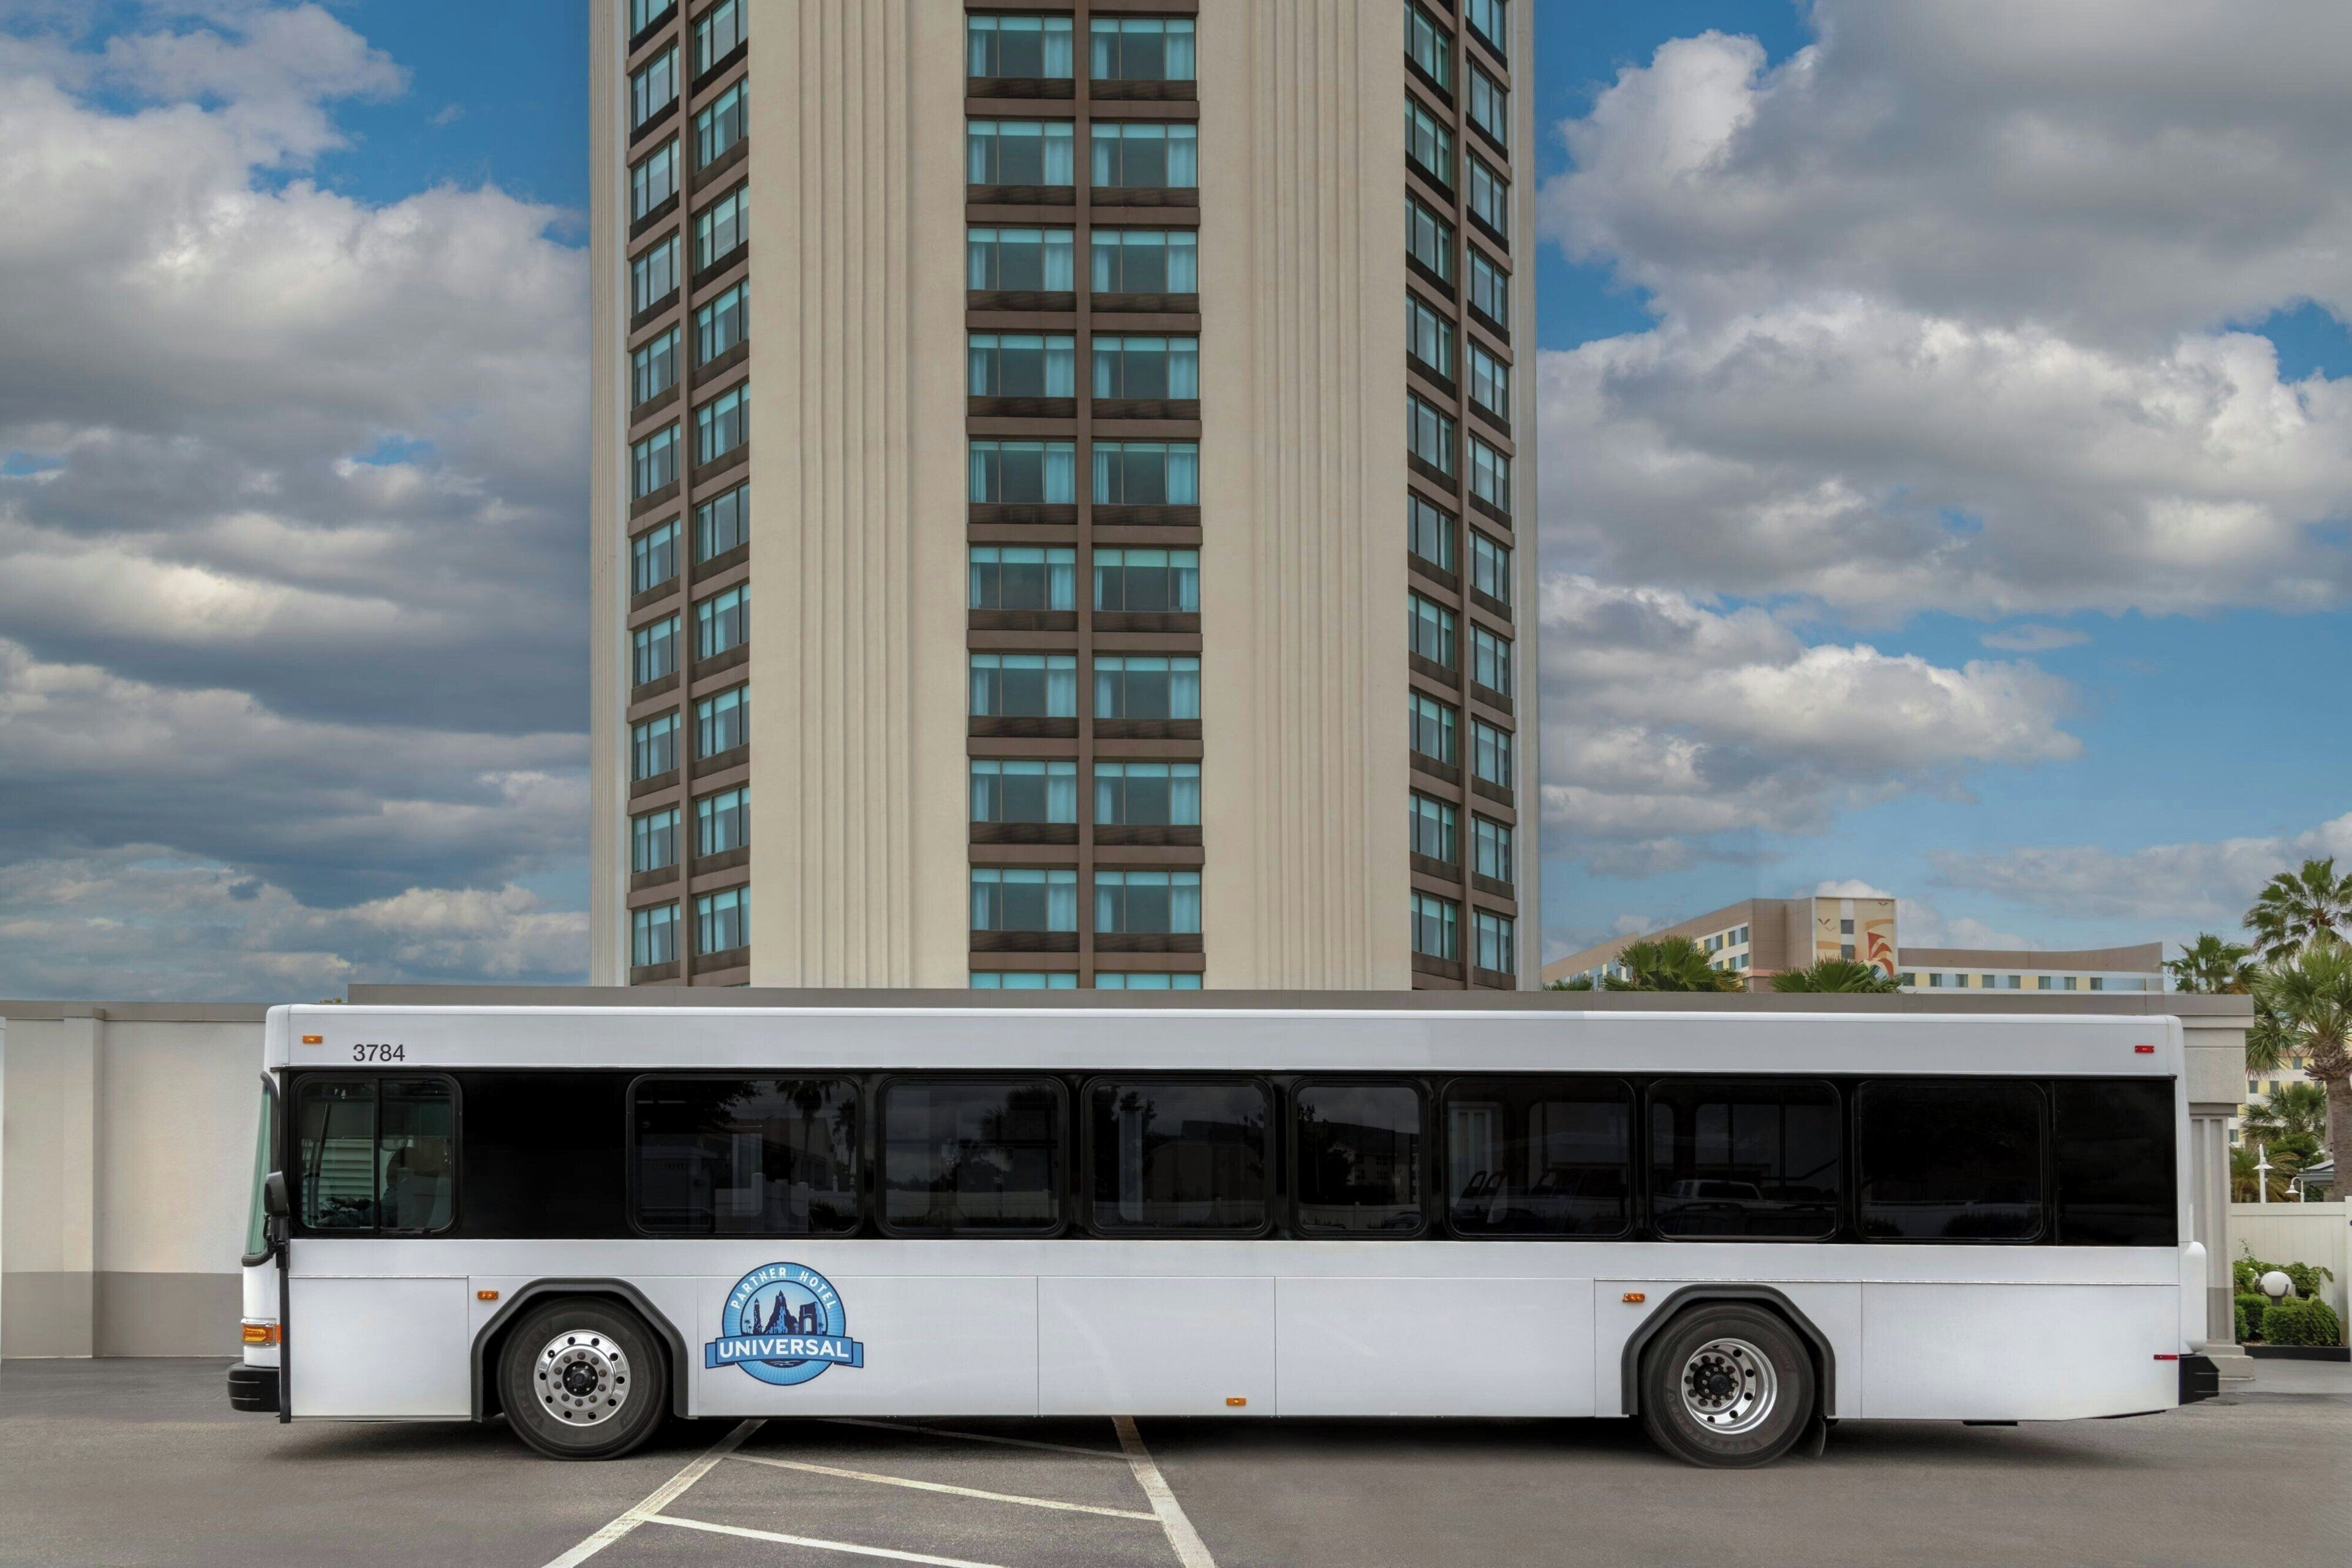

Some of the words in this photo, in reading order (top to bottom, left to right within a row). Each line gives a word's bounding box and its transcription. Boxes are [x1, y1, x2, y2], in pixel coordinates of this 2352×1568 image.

[353, 1044, 405, 1062] 3784
[730, 1267, 787, 1310] PARTNER
[799, 1270, 837, 1310] HOTEL
[719, 1338, 849, 1359] UNIVERSAL
